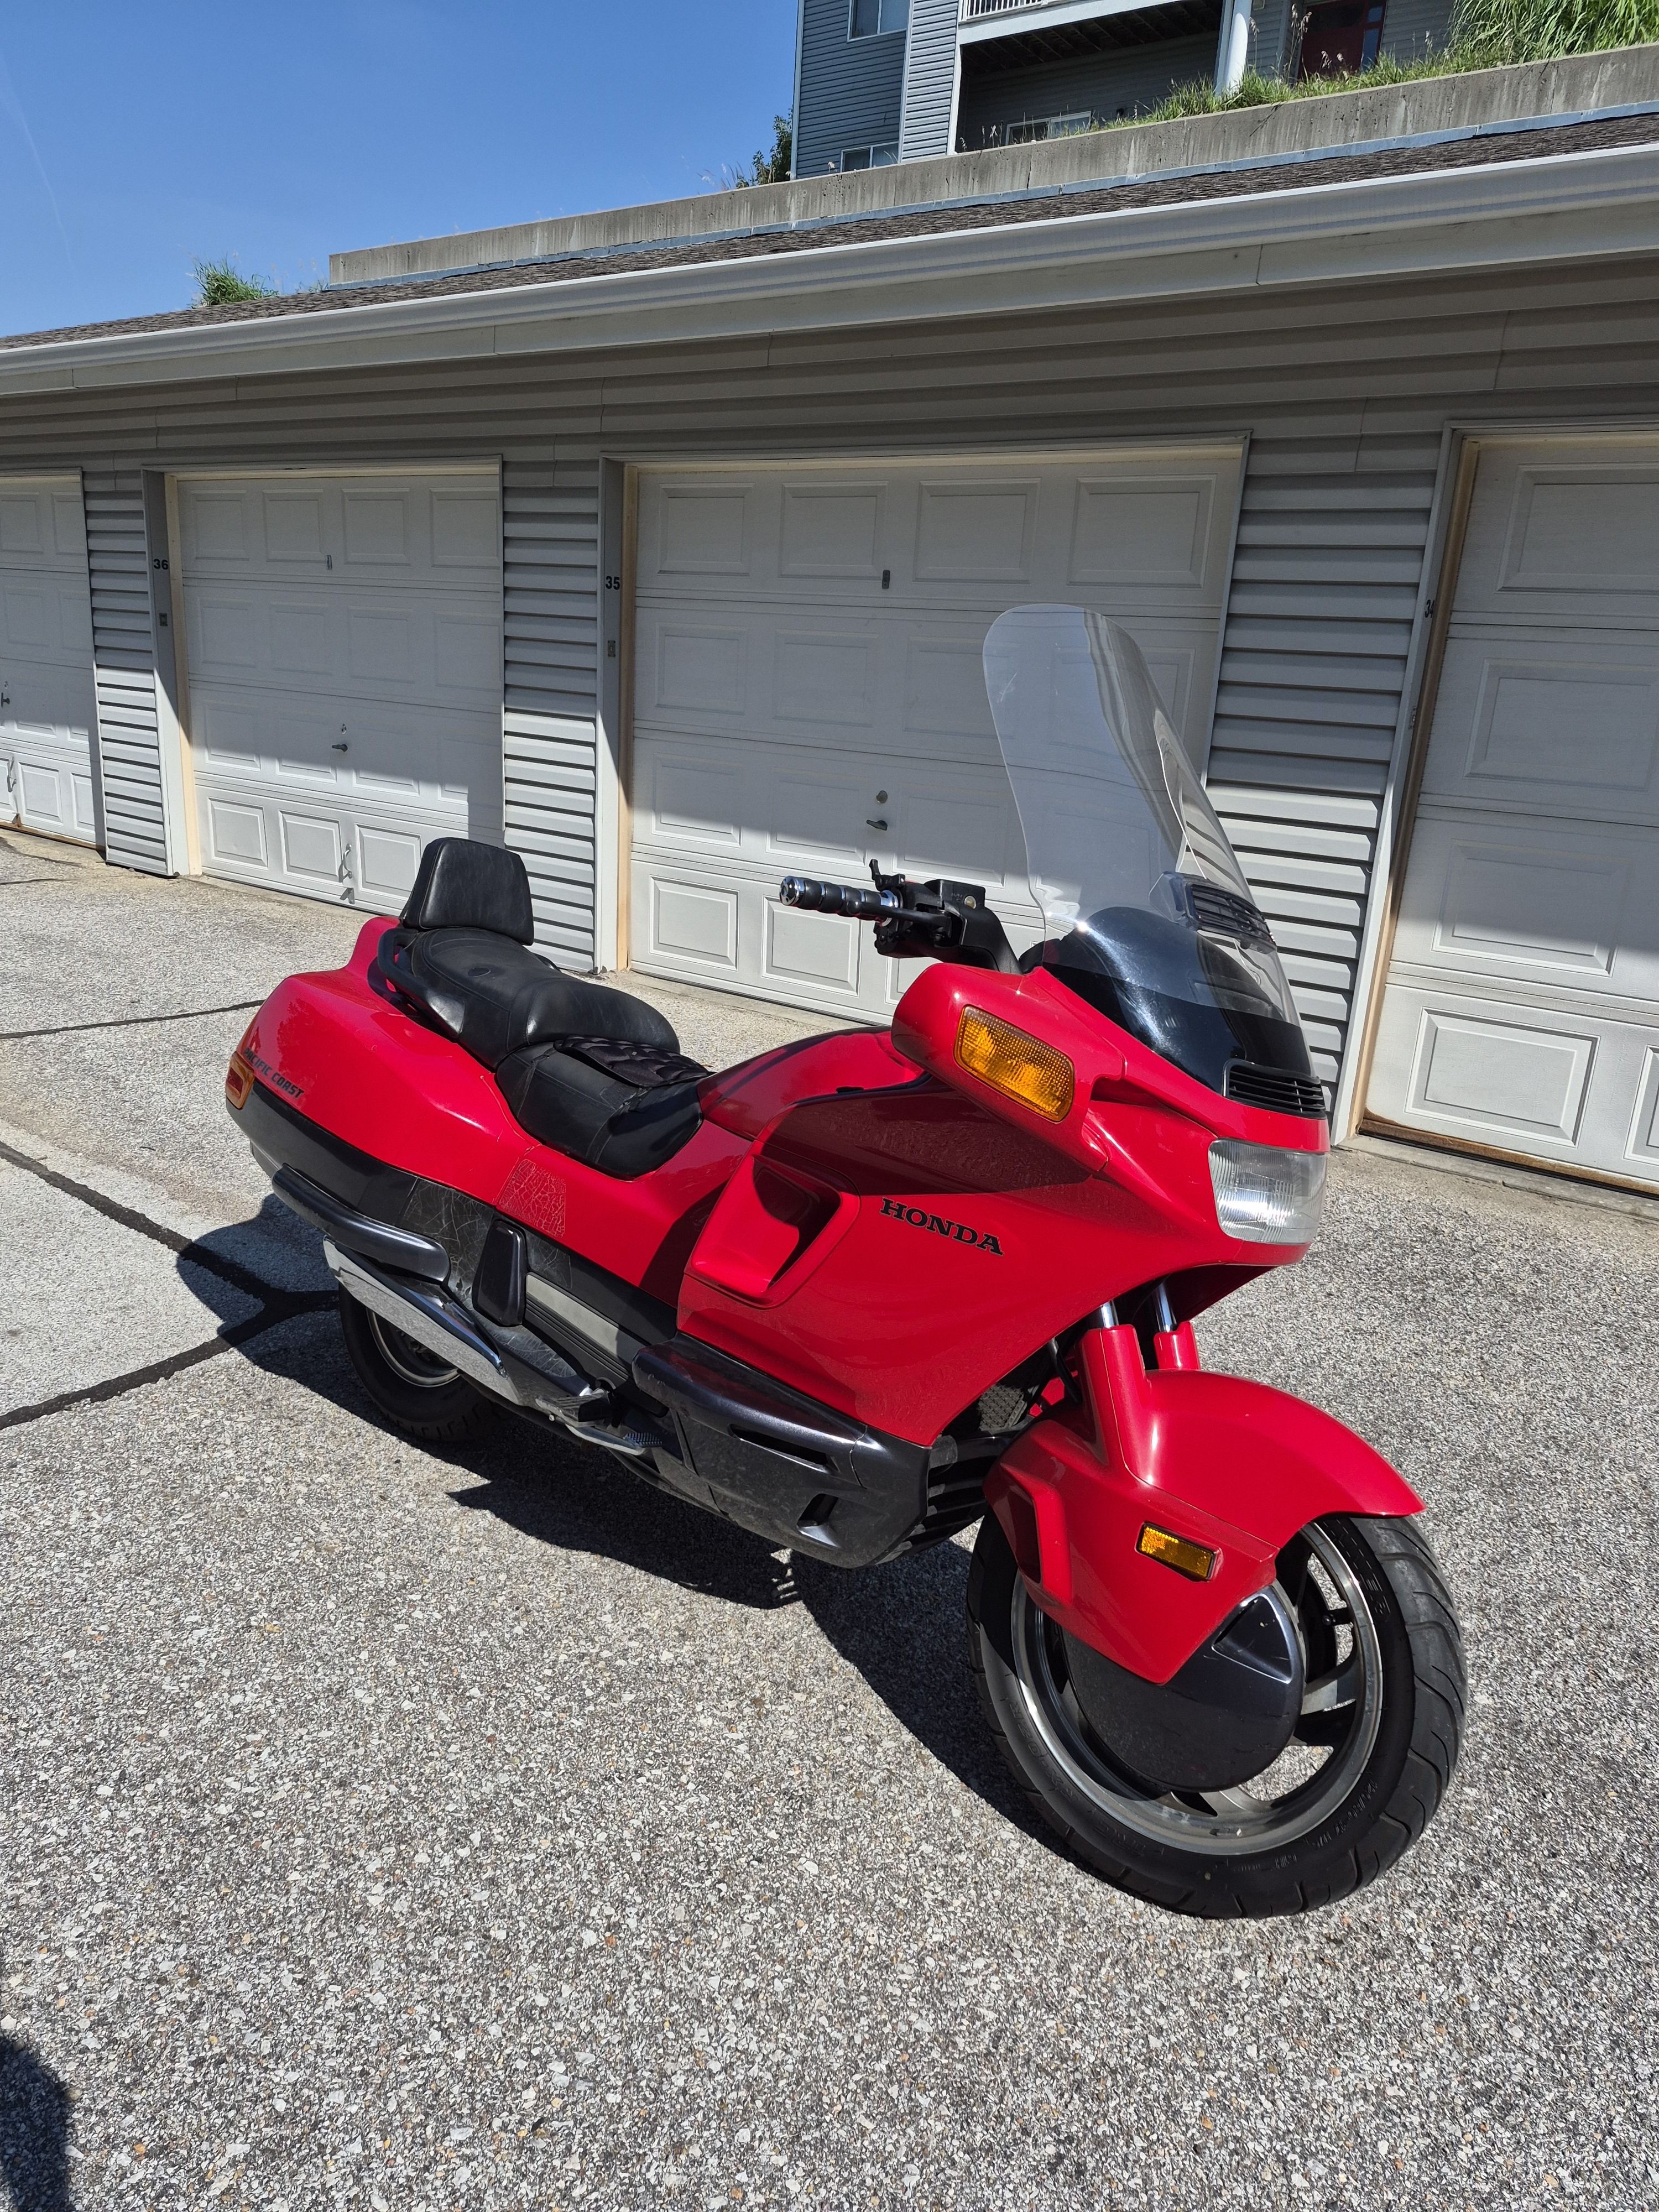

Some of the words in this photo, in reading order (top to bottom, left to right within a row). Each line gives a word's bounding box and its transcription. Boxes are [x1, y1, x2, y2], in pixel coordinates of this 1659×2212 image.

[153, 559, 169, 570] 36
[605, 576, 620, 590] 35
[1425, 600, 1435, 618] 34
[243, 1047, 273, 1076] PACIFIC
[271, 1072, 305, 1098] COAST
[880, 1197, 1004, 1256] HONDA
